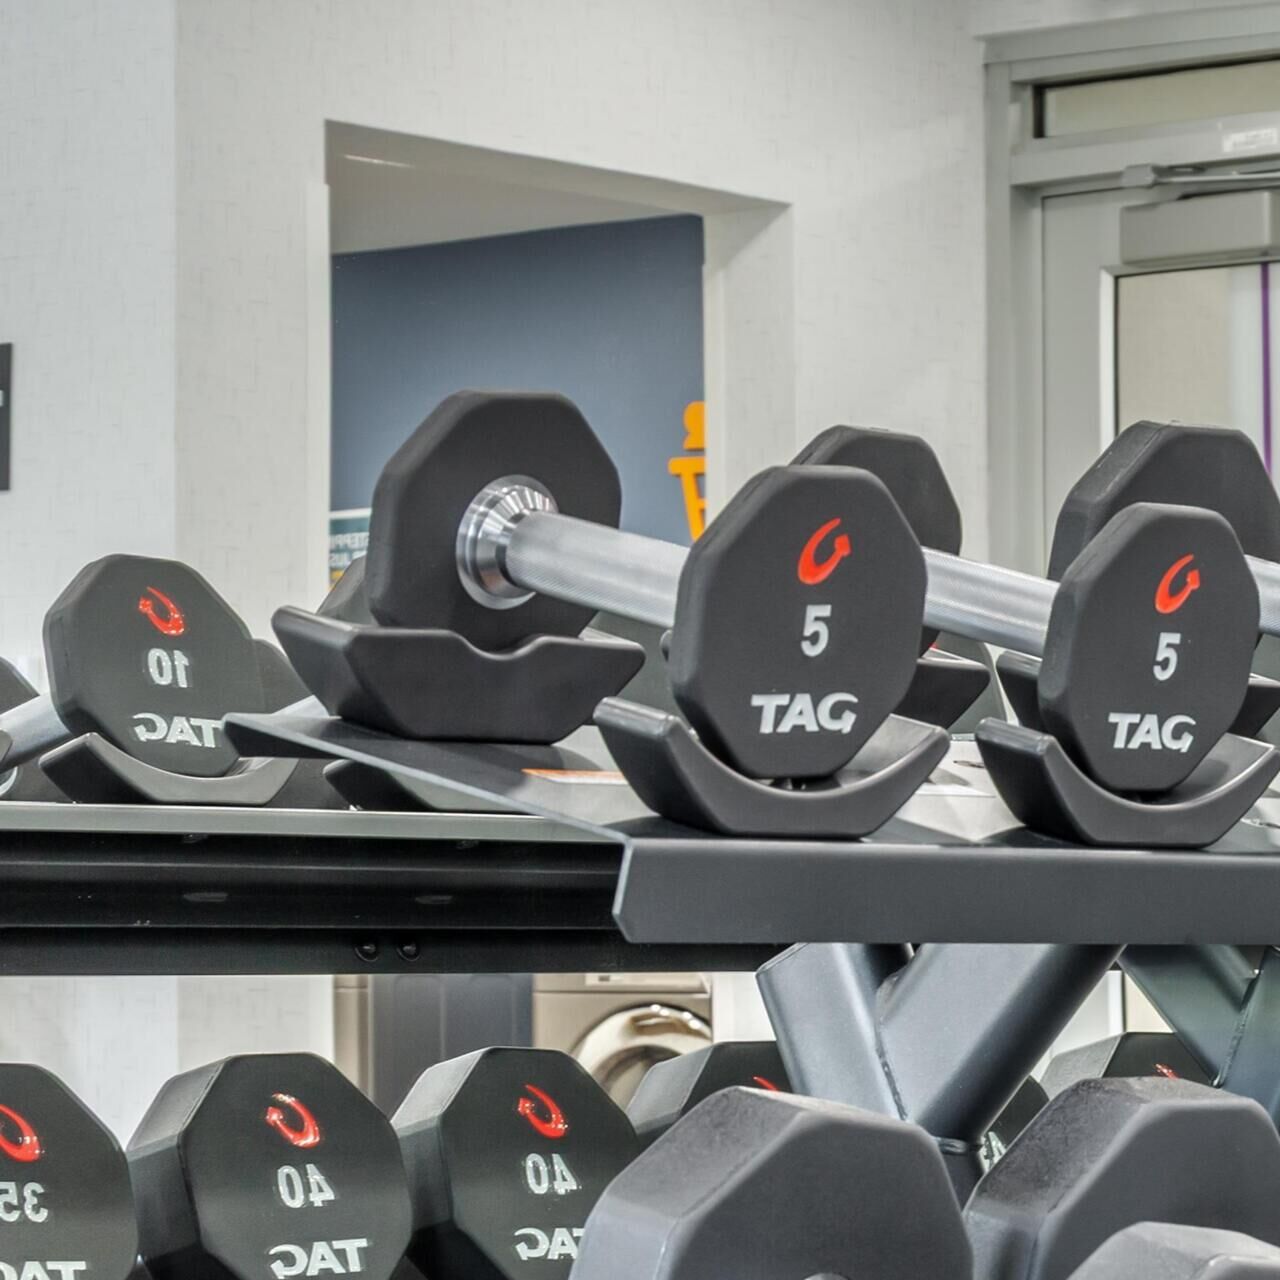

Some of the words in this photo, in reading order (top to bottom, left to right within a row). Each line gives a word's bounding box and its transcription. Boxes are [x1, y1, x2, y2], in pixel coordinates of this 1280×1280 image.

[801, 605, 831, 656] 5
[1154, 632, 1181, 680] 5
[751, 693, 858, 734] TAG
[1108, 713, 1196, 752] TAG
